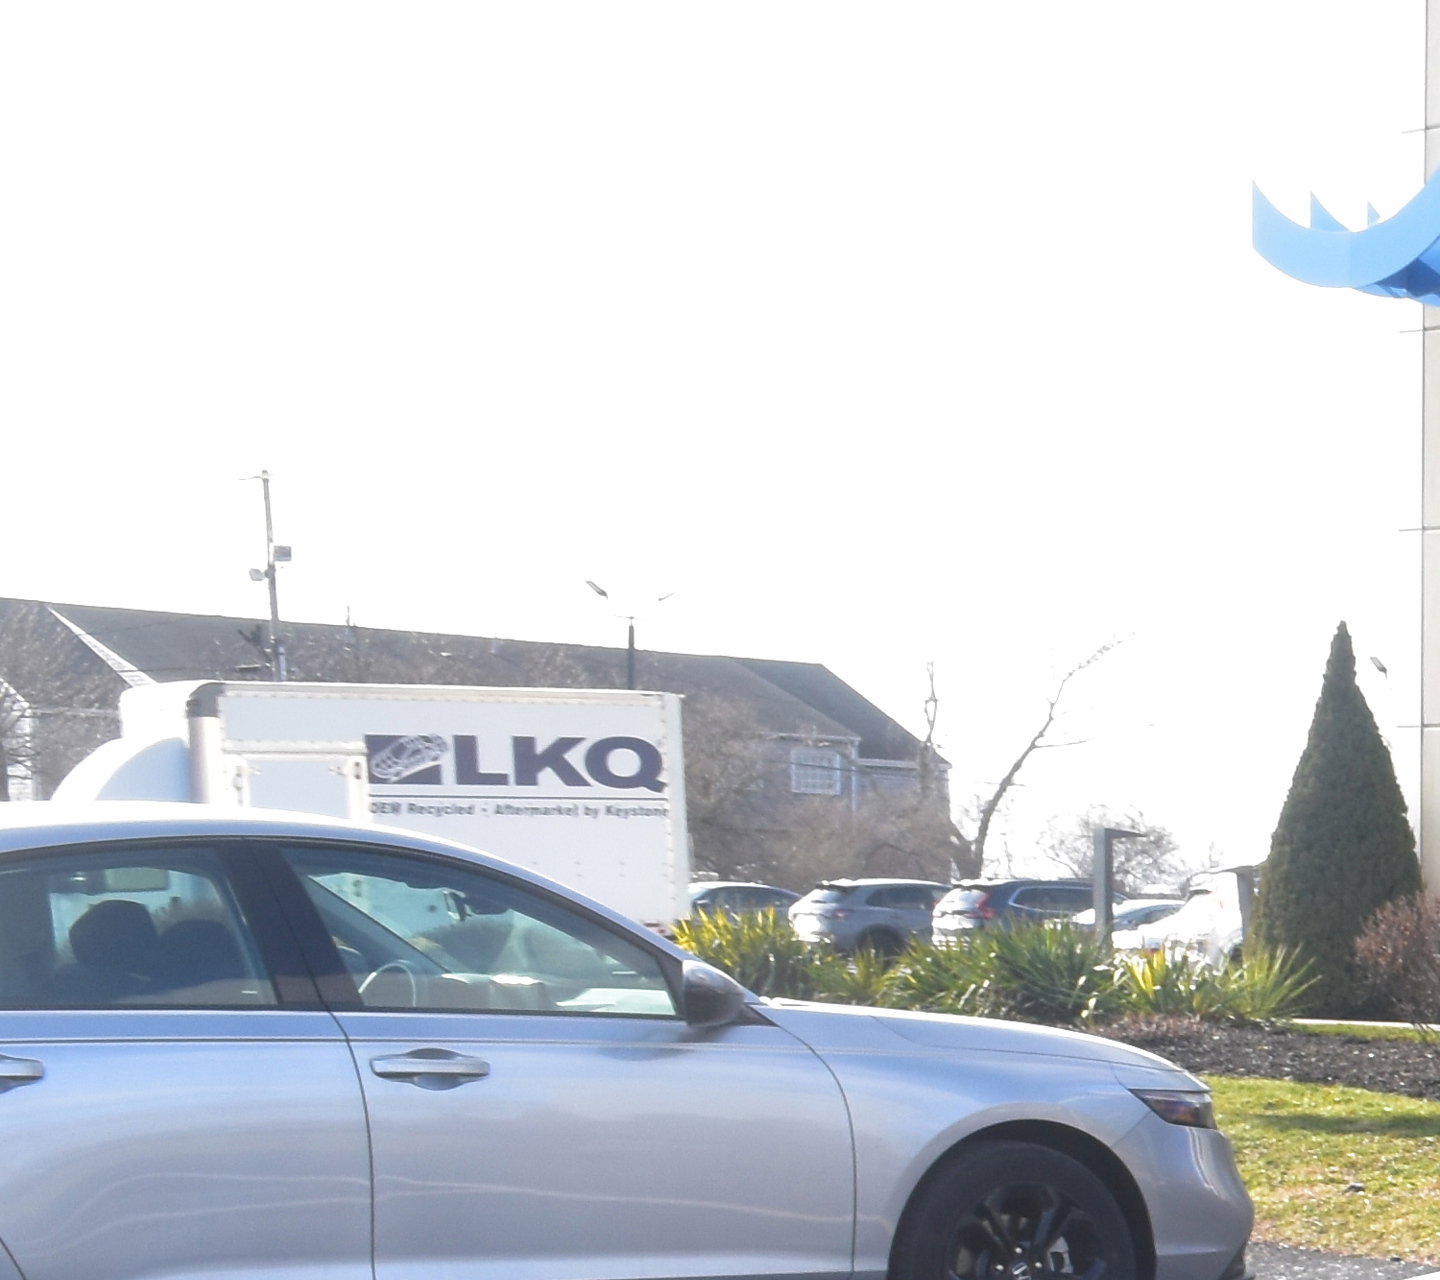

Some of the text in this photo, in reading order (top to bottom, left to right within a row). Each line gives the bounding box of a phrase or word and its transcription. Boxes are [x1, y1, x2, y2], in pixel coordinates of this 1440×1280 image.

[453, 734, 668, 793] LKQ
[407, 802, 475, 818] Recycled
[494, 803, 578, 816] Aftermarket
[584, 804, 598, 819] by
[605, 804, 669, 819] Keystone
